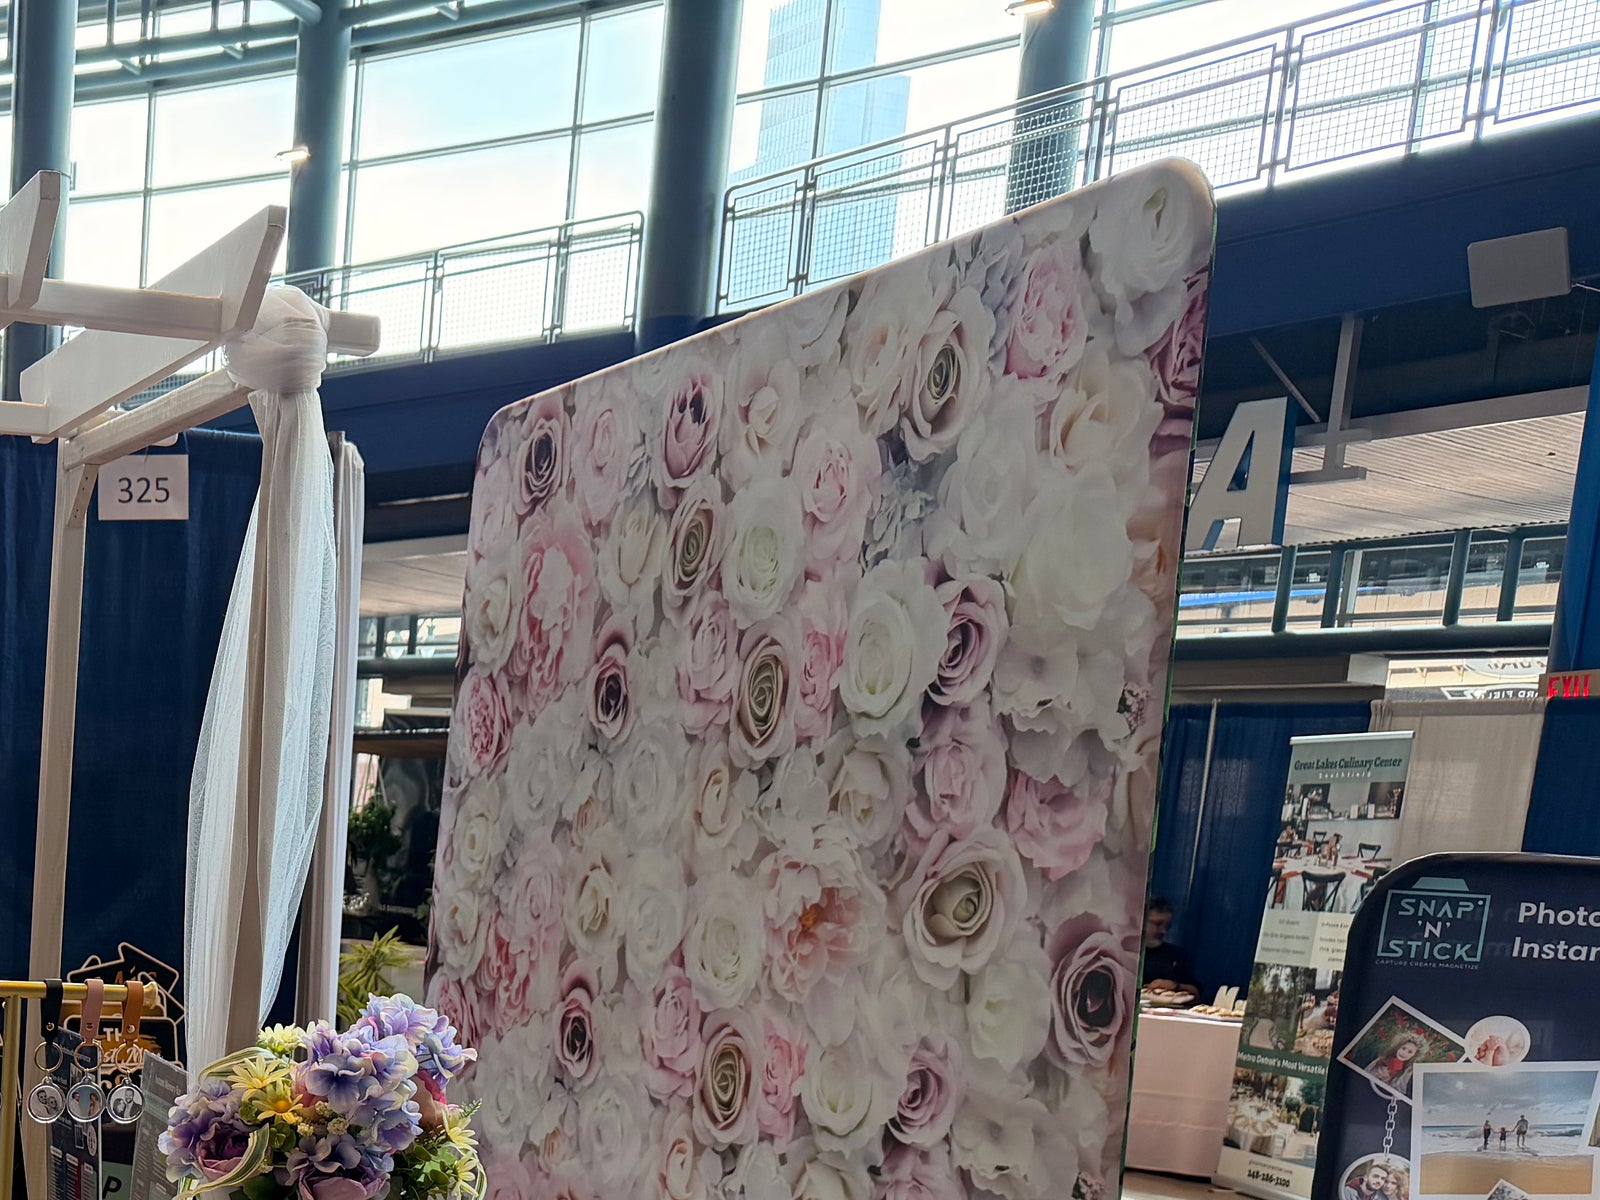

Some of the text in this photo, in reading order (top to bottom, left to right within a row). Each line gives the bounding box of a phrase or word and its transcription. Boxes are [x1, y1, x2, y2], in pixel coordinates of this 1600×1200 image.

[1184, 396, 1288, 551] A
[117, 476, 170, 504] 325
[1547, 674, 1592, 698] EXIT
[1293, 756, 1403, 771] Great Lakes Culinary Center
[1398, 898, 1475, 920] SNAP
[1388, 939, 1473, 961] STICK
[1236, 1051, 1257, 1062] Metro
[1281, 1059, 1298, 1070] Most
[1298, 1061, 1326, 1075] Versatile
